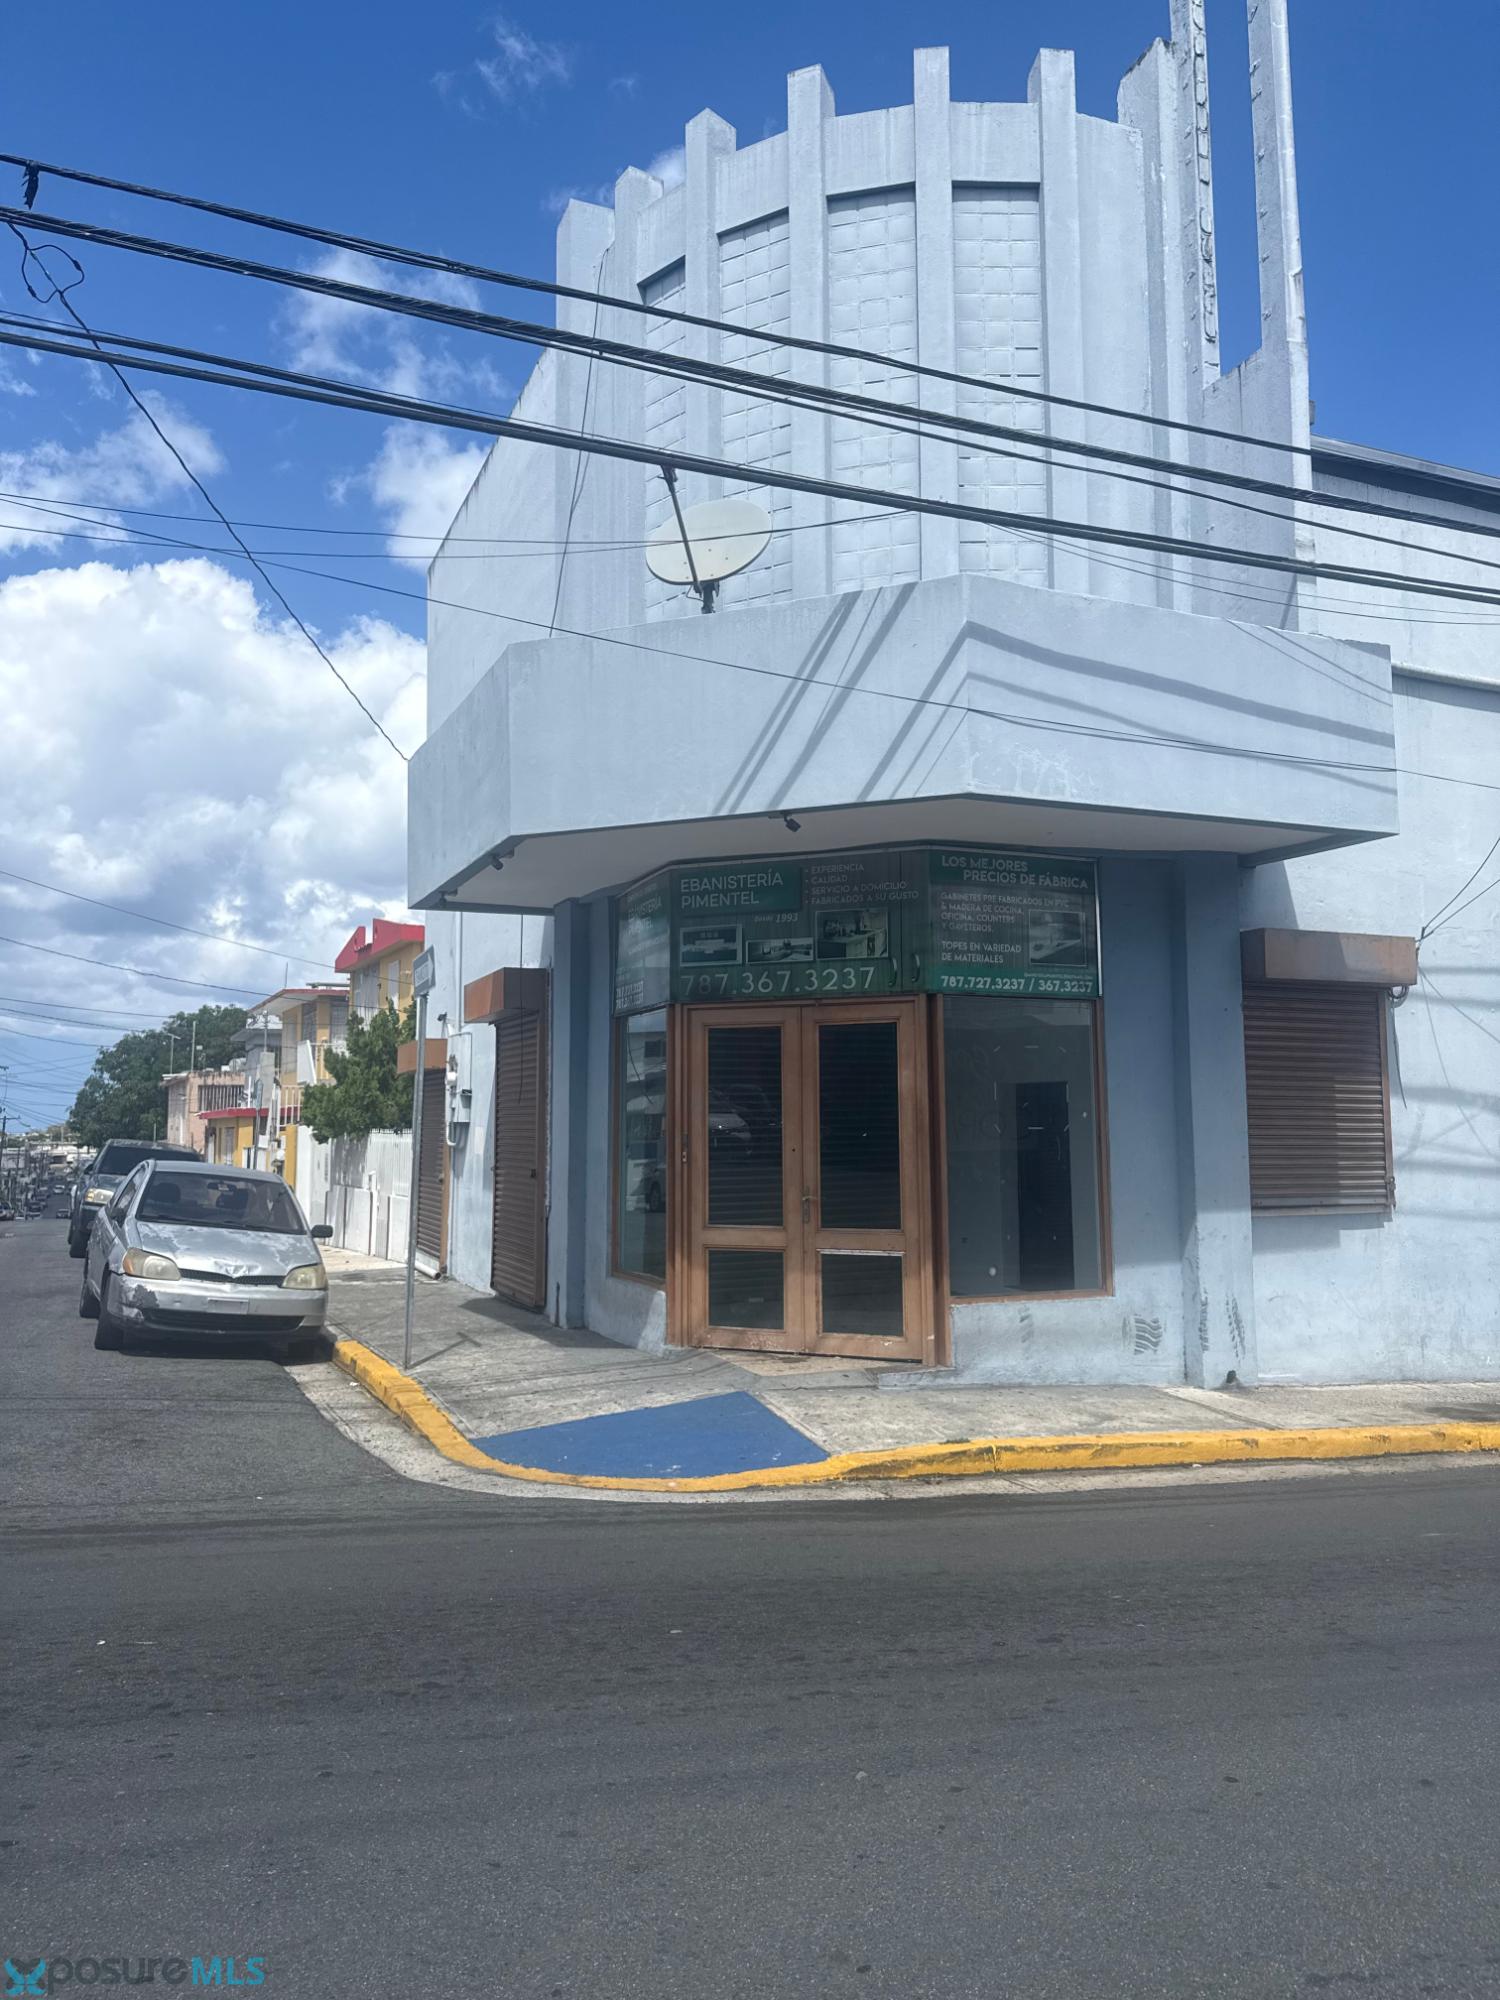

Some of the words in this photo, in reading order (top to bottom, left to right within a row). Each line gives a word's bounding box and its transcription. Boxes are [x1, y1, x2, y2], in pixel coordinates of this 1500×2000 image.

[811, 863, 865, 874] EXPERIENCIA
[941, 855, 967, 868] LOS
[970, 857, 1029, 872] MEJORES
[680, 868, 784, 893] EBANISTERÍA
[811, 874, 848, 884] CALIDAD
[963, 869, 1017, 884] PRECIOS
[1020, 874, 1036, 886] DE
[1038, 872, 1089, 889] FÁBRICA
[811, 885, 851, 896] SERVICIO
[854, 884, 860, 892] A
[861, 880, 908, 891] DOMICILIO
[681, 891, 760, 909] PIMENTEL
[888, 890, 920, 900] GUSTO
[998, 895, 1043, 907] FABRICADOS
[949, 903, 981, 912] MADERA
[983, 904, 993, 913] DE
[776, 911, 799, 923] 1993
[941, 941, 968, 952] TOPES
[969, 942, 981, 952] EN
[982, 943, 1022, 954] VARIEDAD
[940, 952, 953, 962] DE
[954, 953, 1004, 964] MATERIALES
[680, 966, 876, 997] 787.367.3237
[940, 974, 1026, 991] 787.727.3237
[1038, 979, 1094, 993] 367.3237
